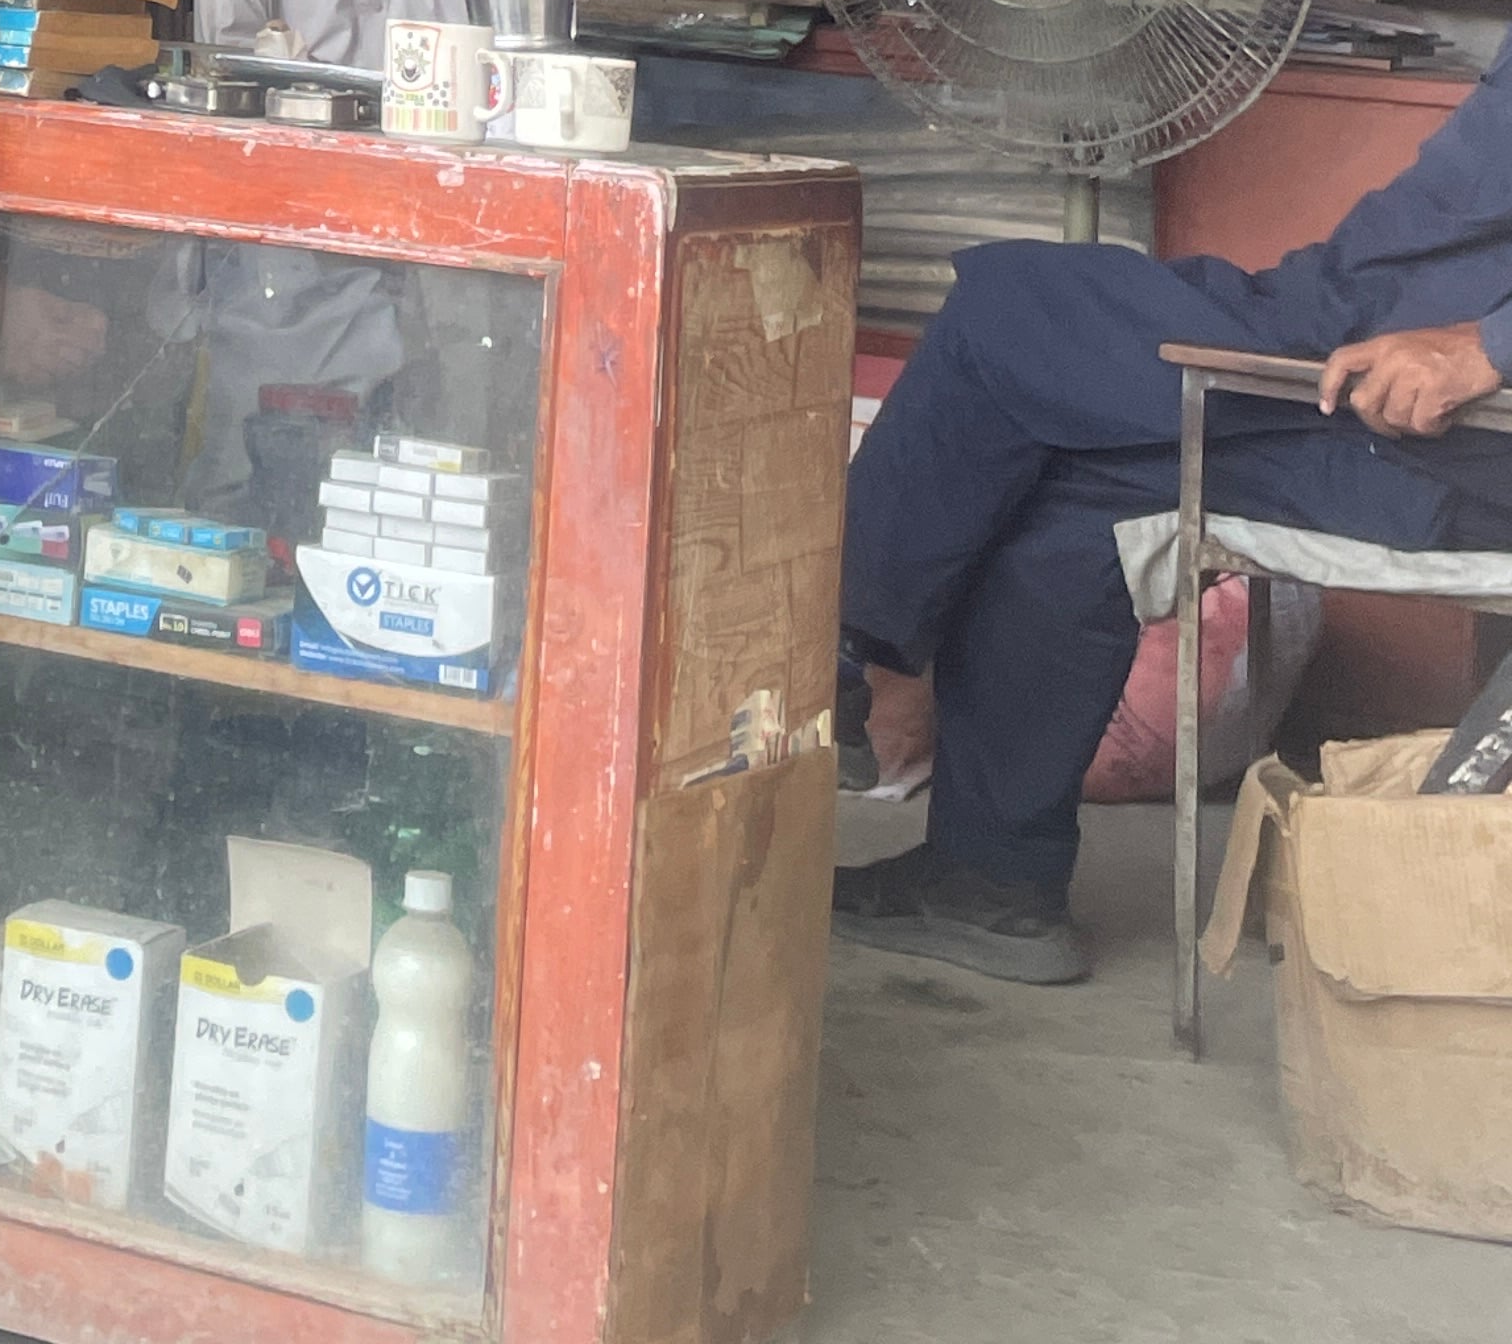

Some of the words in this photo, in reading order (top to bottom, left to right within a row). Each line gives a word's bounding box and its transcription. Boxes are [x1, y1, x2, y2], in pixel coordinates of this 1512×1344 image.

[384, 580, 438, 604] TICK
[90, 597, 150, 621] STAPLES
[382, 613, 431, 634] STAPLES
[20, 978, 55, 1004] DRY
[56, 987, 113, 1016] ERASE
[195, 1016, 231, 1046] DRY
[233, 1026, 291, 1056] ERASE
